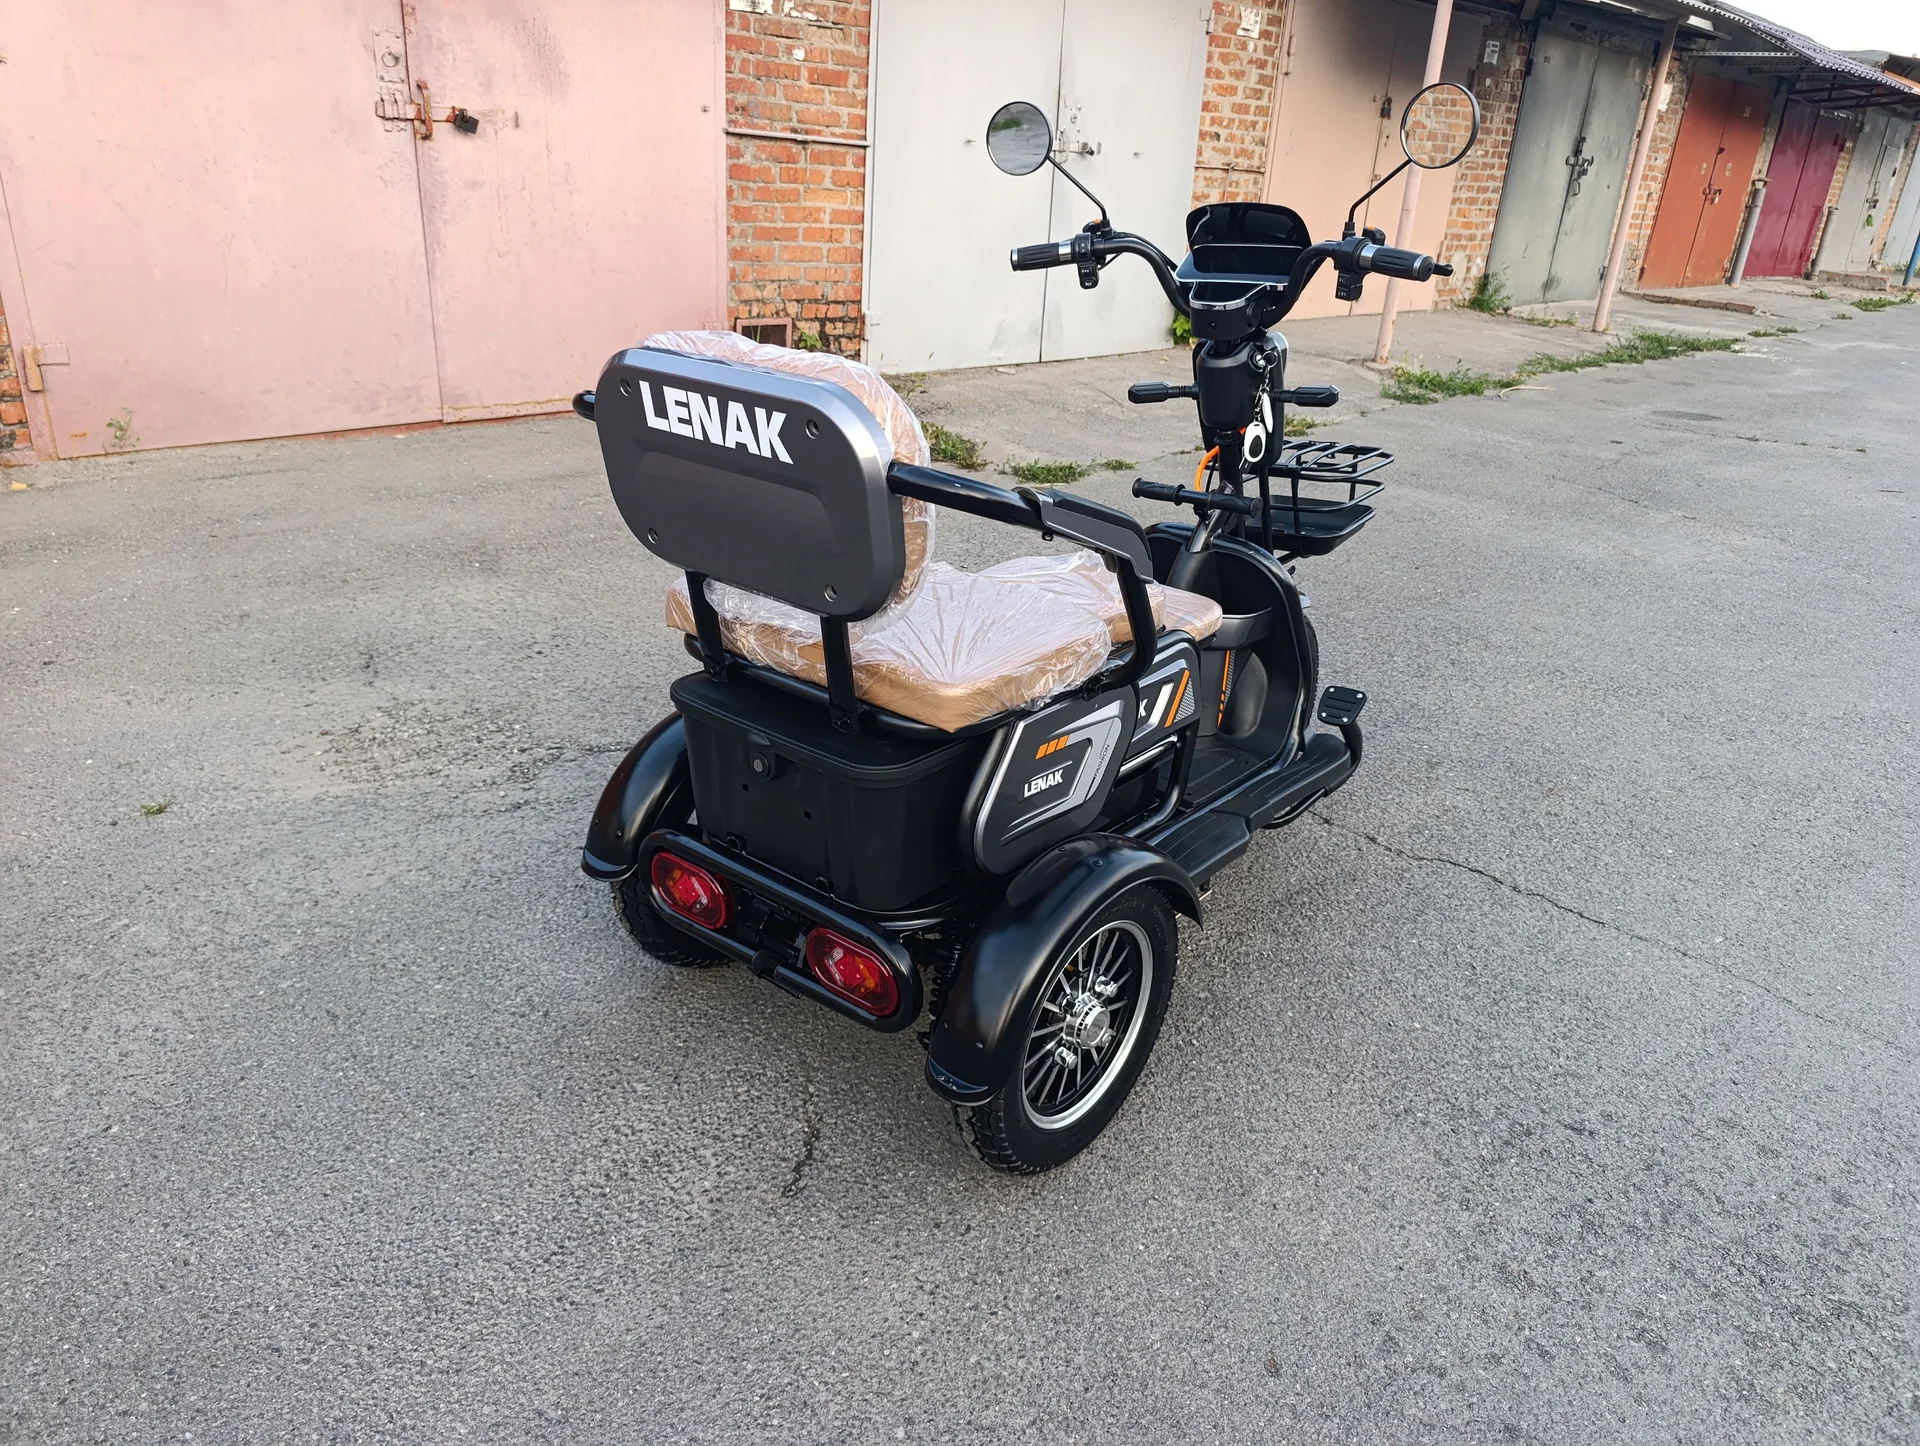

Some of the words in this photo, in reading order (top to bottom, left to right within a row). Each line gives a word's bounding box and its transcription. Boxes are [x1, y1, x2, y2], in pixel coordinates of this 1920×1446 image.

[638, 380, 794, 465] LENAK
[1094, 744, 1110, 778] FASHION
[1024, 769, 1063, 797] LENAK
